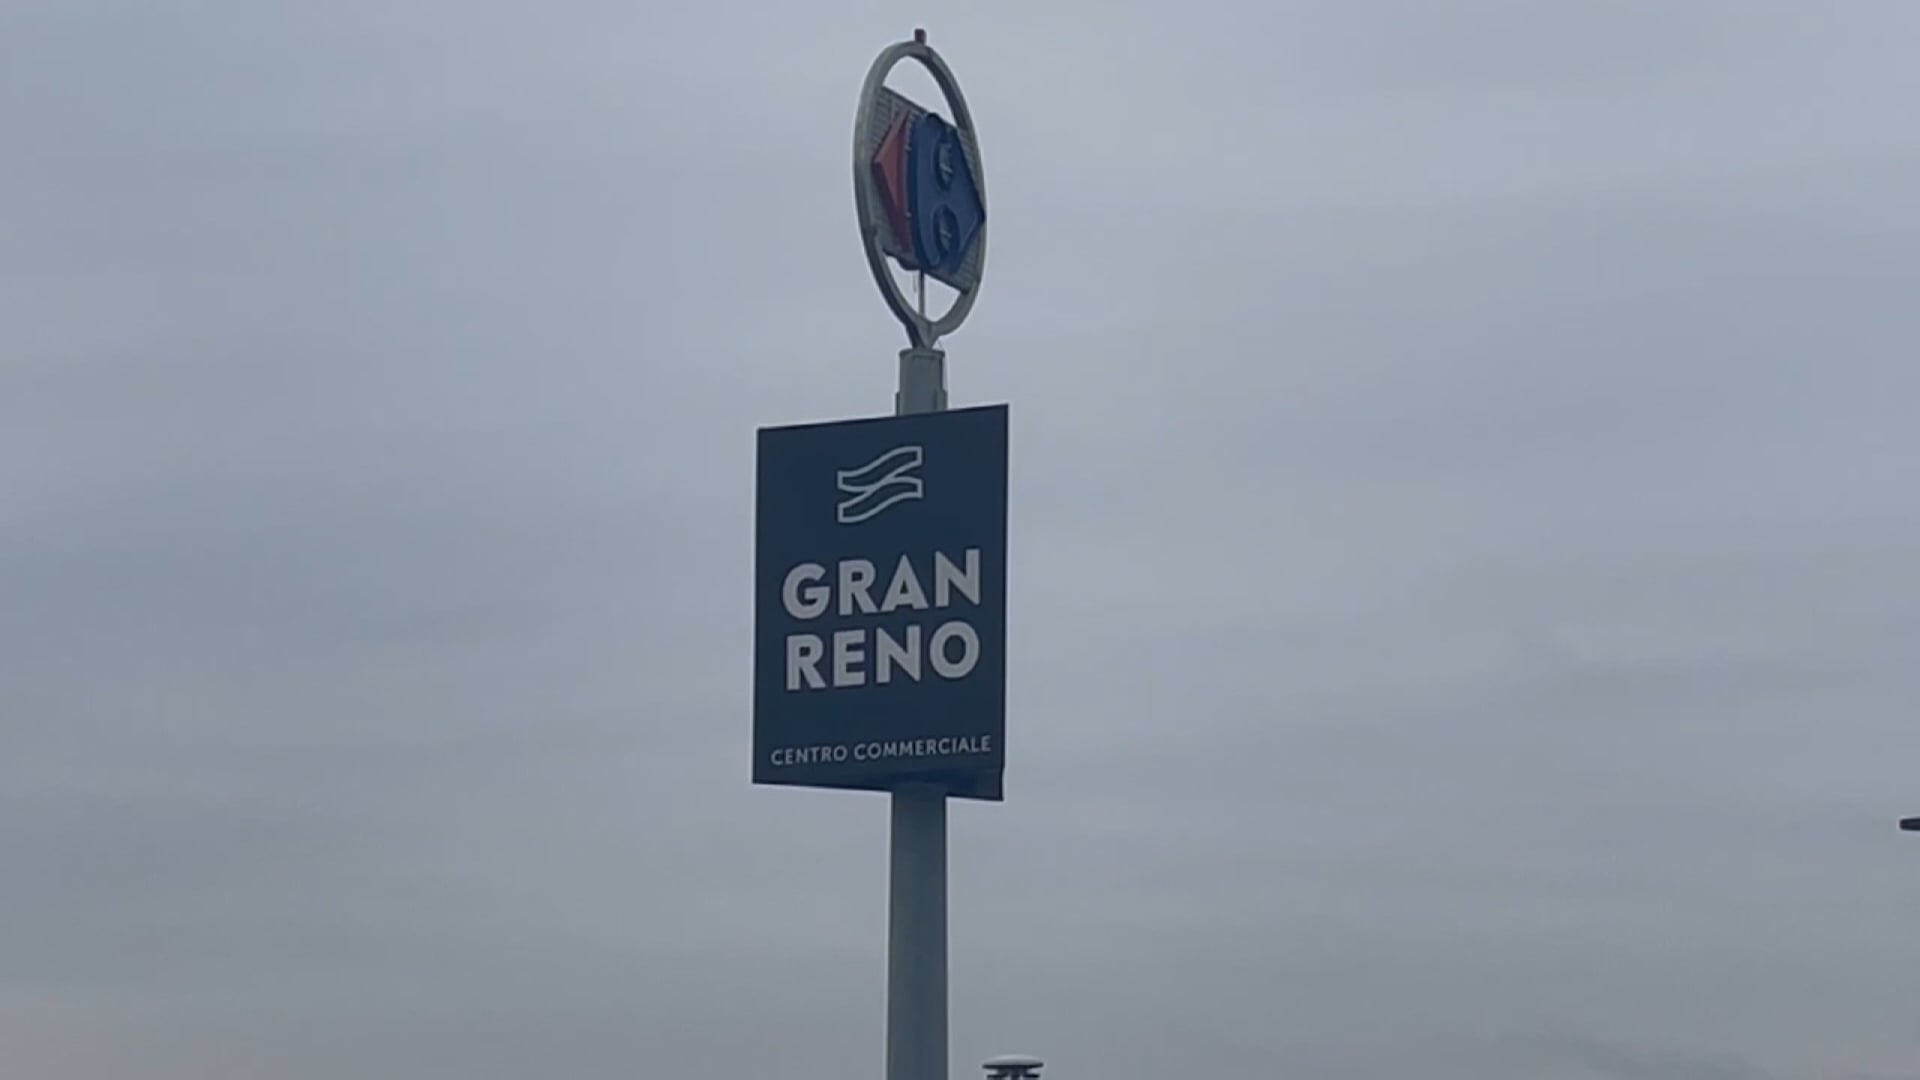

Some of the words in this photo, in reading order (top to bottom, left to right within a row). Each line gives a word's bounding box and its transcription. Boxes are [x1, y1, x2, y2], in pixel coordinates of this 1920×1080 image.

[783, 549, 980, 619] GRAN
[786, 621, 980, 690] RENO
[770, 745, 848, 766] CENTRO
[853, 735, 992, 760] COMMERCIALE
